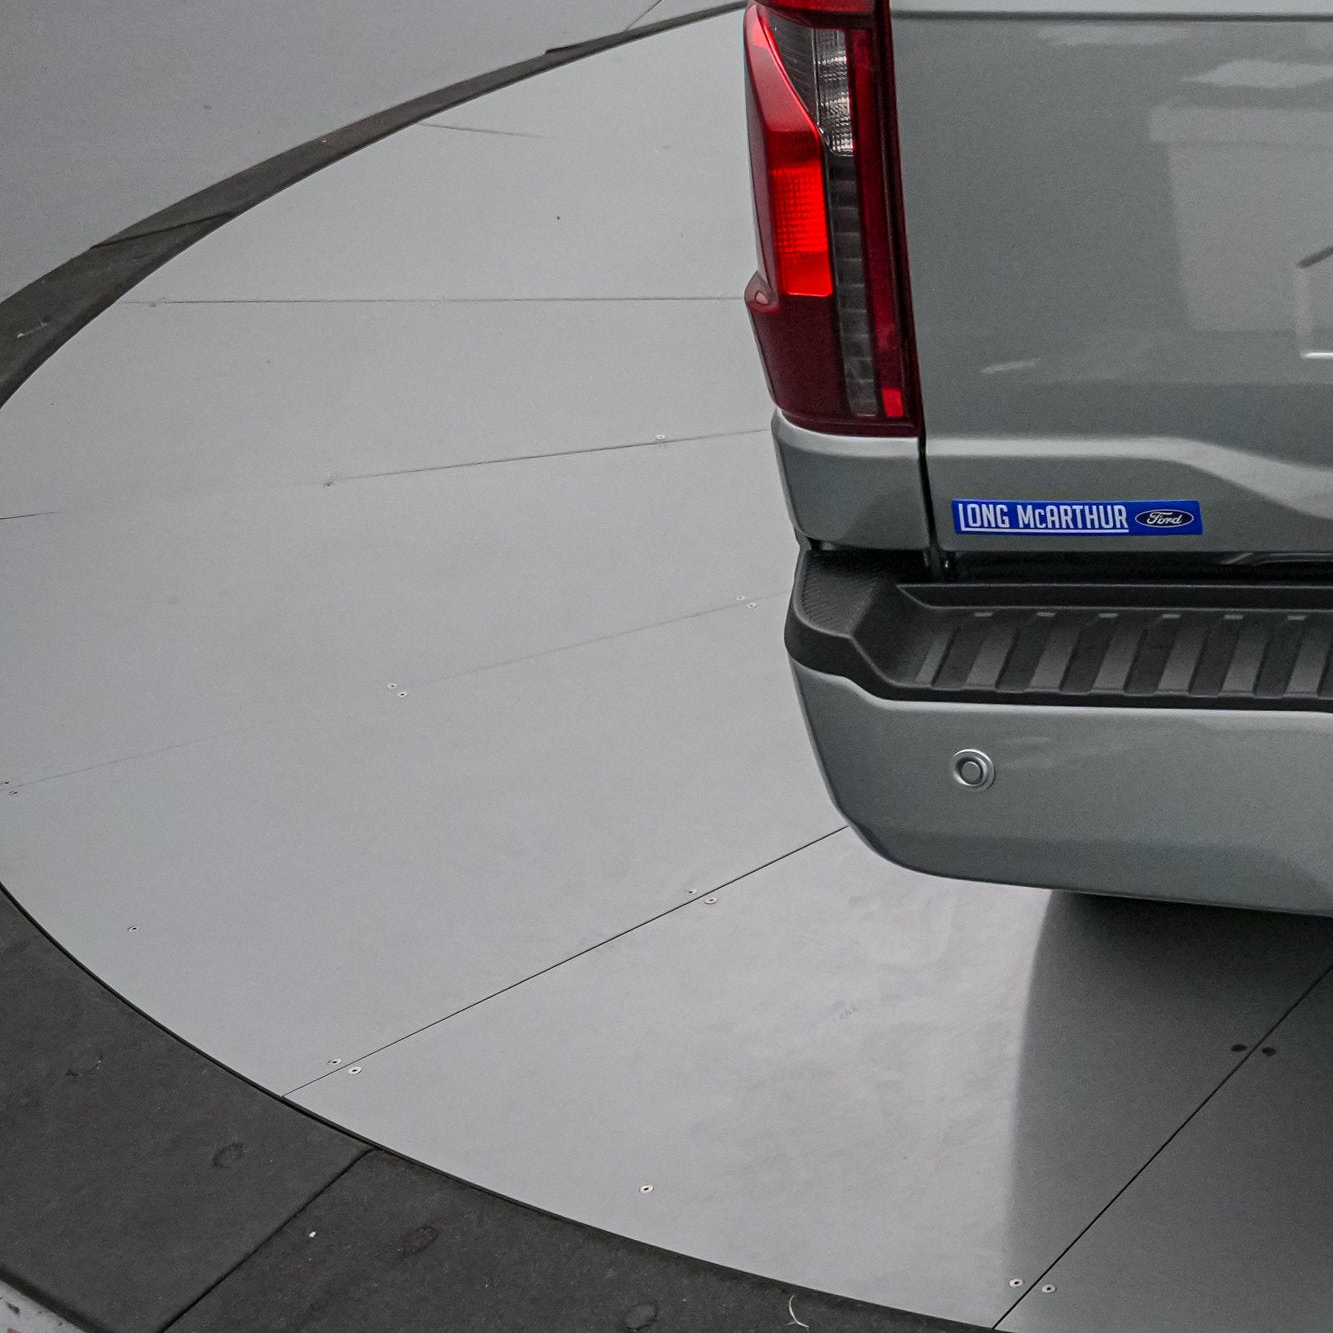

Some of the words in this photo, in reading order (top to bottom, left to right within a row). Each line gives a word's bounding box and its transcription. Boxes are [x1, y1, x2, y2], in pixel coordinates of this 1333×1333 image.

[958, 503, 1010, 532] LONG
[1016, 504, 1129, 529] McARTHUR
[1146, 511, 1183, 526] Ford
